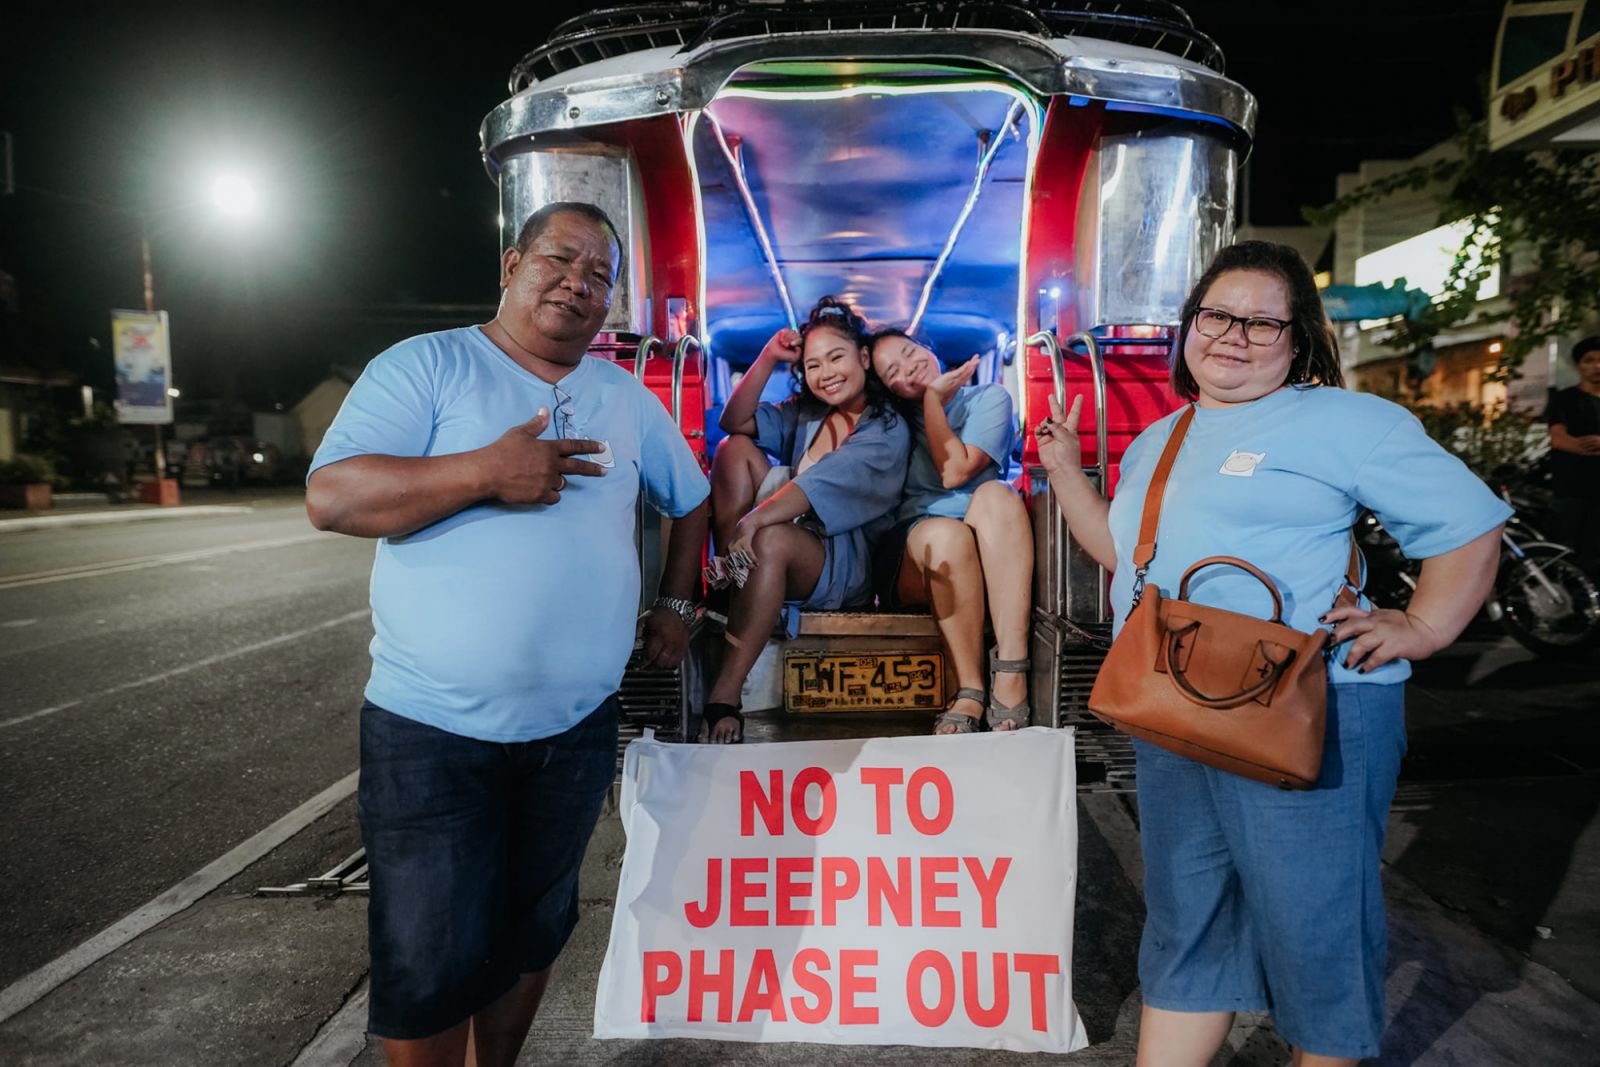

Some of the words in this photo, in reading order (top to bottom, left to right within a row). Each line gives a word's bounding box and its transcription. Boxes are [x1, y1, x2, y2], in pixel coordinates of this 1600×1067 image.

[870, 659, 937, 691] 453
[740, 767, 837, 836] NO
[861, 766, 955, 836] TO
[684, 857, 1012, 928] JEEPNEY
[641, 948, 878, 1024] PHASE
[906, 950, 1059, 1032] OUT
